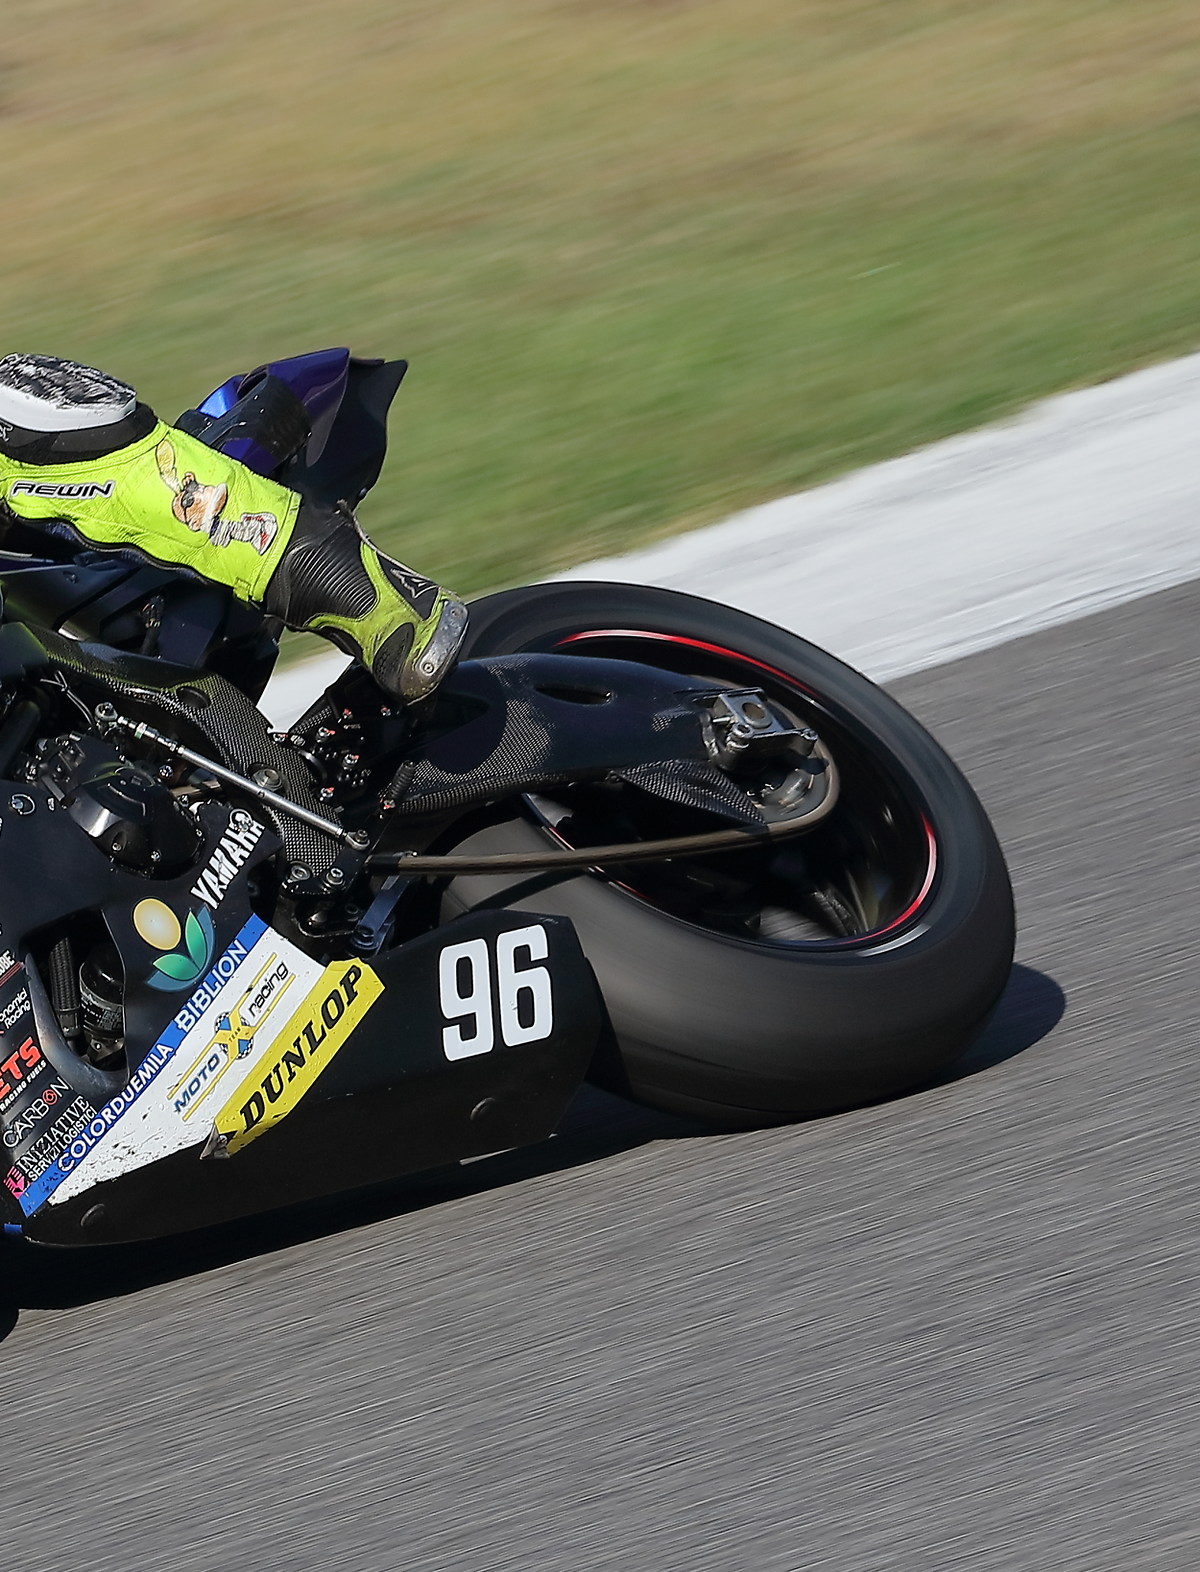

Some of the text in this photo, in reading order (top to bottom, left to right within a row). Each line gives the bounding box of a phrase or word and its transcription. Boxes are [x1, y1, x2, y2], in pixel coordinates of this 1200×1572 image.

[11, 481, 112, 498] REWIN
[4, 1001, 31, 1030] Racing
[439, 924, 553, 1062] 96
[58, 940, 248, 1172] COLORDUEMILA BIBLION
[173, 1053, 220, 1113] MOTO
[248, 961, 289, 1018] racing
[228, 1027, 241, 1043] TEAM
[240, 964, 363, 1133] DUNLOP
[0, 1060, 47, 1112] RACING FUELS
[16, 1096, 89, 1173] INIZIATIVE
[28, 1106, 98, 1181] SERVIZI LOGISTICI
